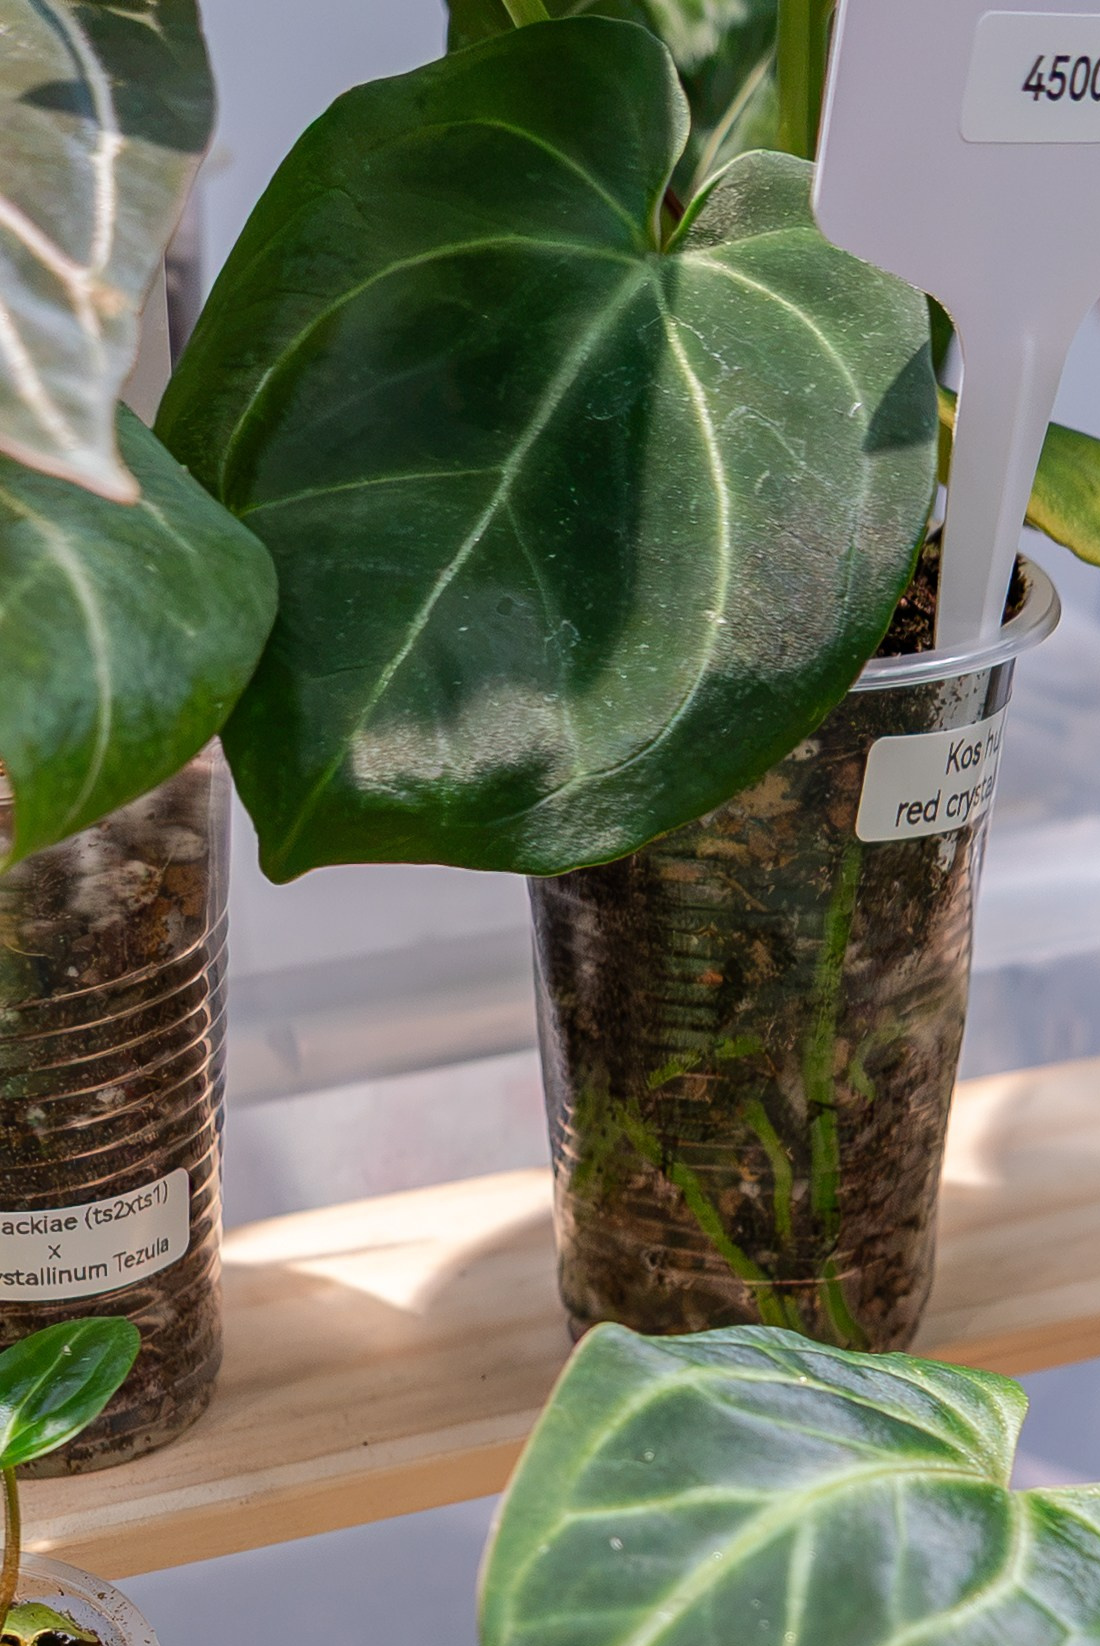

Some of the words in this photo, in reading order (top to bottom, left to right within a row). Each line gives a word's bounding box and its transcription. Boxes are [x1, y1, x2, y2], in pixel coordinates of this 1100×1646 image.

[945, 738, 982, 776] Kos
[895, 788, 941, 828] red
[84, 1180, 169, 1231] (ts2xts1)
[0, 1262, 108, 1287] stallinum
[113, 1237, 170, 1273] Tezula
